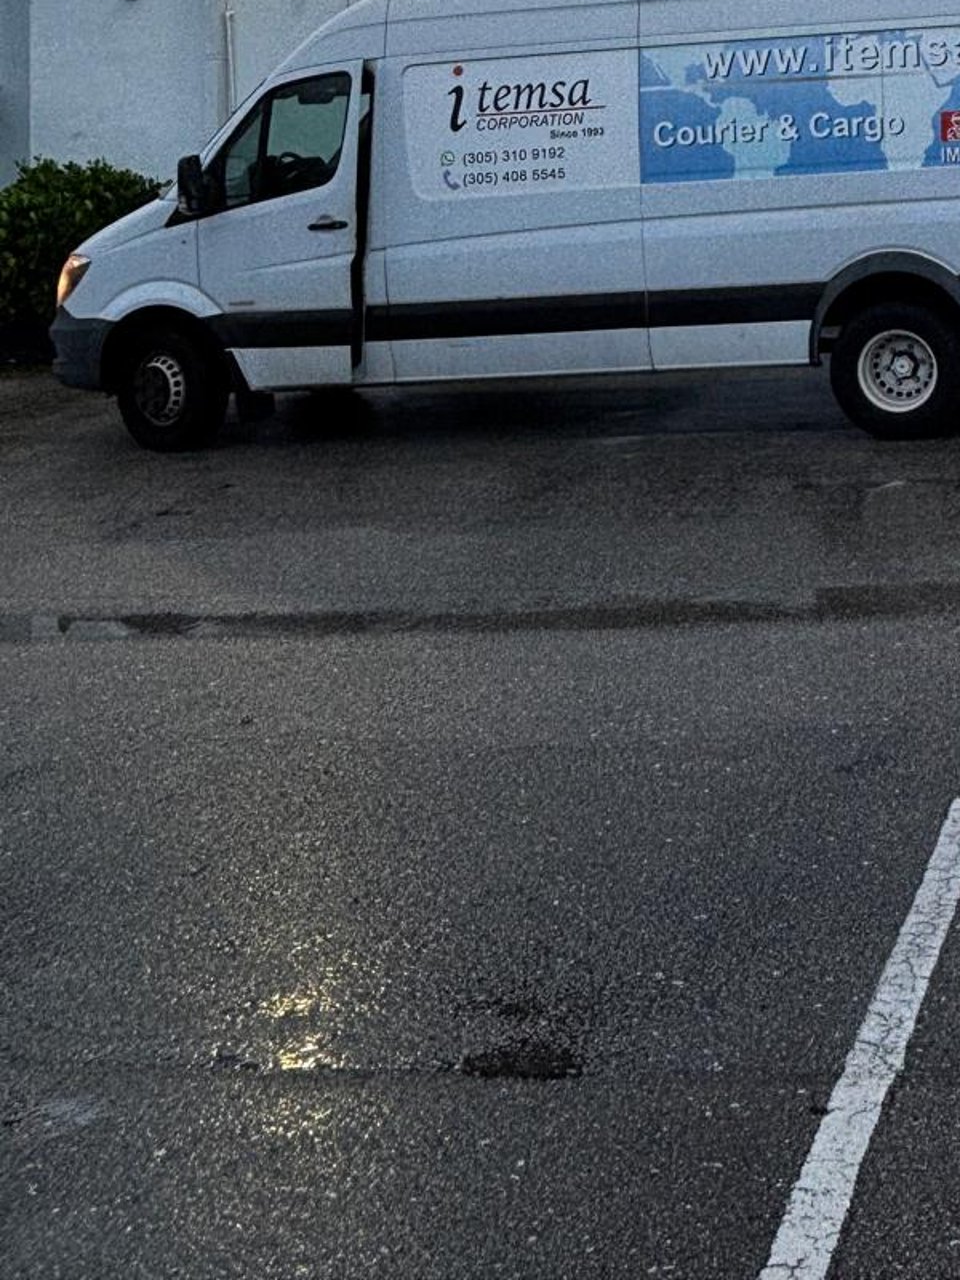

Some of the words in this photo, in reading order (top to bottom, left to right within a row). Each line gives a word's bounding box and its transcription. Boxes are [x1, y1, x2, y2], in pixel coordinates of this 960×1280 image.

[476, 112, 585, 132] CORPORATION
[653, 118, 769, 148] Courier
[778, 114, 800, 142] &
[809, 111, 905, 143] Cargo
[550, 128, 578, 140] Since
[462, 151, 498, 166] (305)
[502, 148, 527, 162] 310
[532, 147, 565, 160] 9192
[462, 171, 498, 186] (305)
